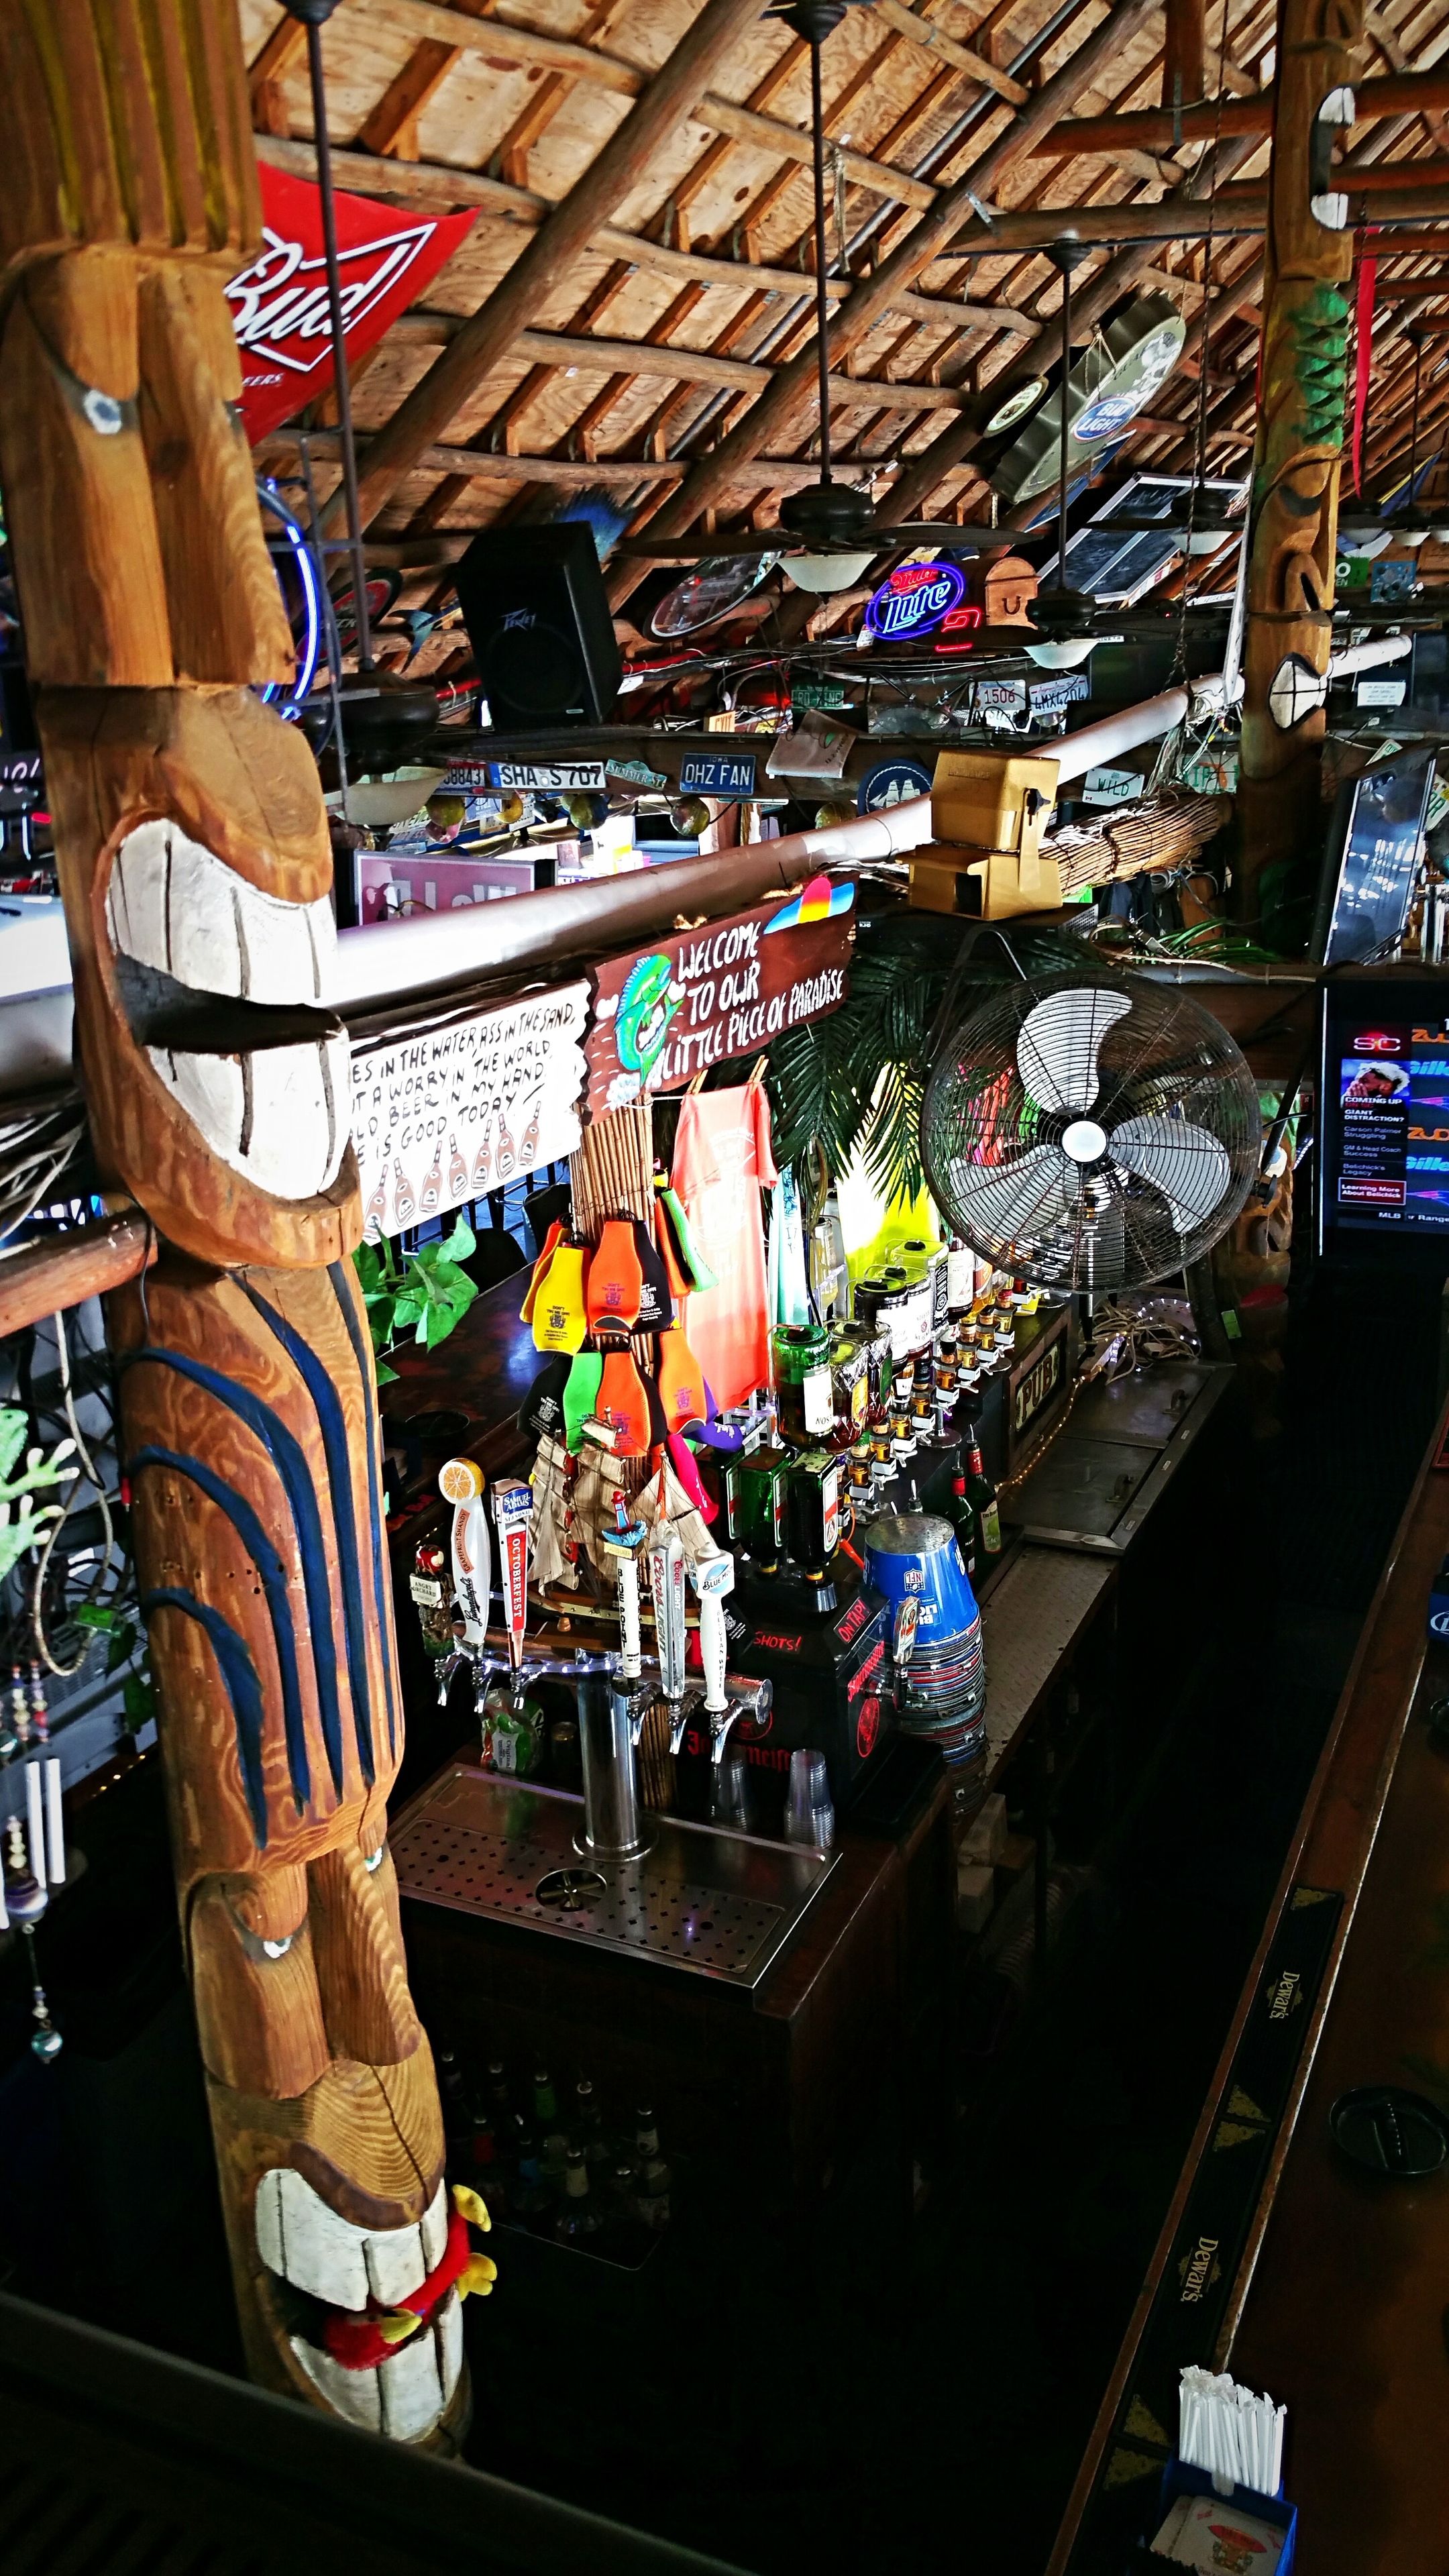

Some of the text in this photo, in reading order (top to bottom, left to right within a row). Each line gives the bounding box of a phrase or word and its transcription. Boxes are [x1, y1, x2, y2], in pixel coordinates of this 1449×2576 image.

[223, 242, 411, 345] Bud
[1097, 402, 1128, 417] BUD
[1077, 418, 1122, 431] LIGHT
[882, 581, 951, 633] Lite
[984, 689, 1016, 704] 1506
[501, 766, 538, 786] SHA
[719, 765, 751, 786] FAN
[1097, 778, 1129, 796] WILD
[678, 922, 761, 981] WELCOME
[686, 960, 761, 1026] TO OUR
[766, 992, 787, 1033] OF
[400, 1042, 427, 1072] THE
[479, 1020, 502, 1048] ASS
[520, 1008, 541, 1036] THE
[1353, 1037, 1401, 1051] SC
[373, 1086, 382, 1108] A
[390, 1067, 448, 1102] WORRY
[474, 1053, 499, 1079] THE
[389, 1093, 439, 1128] BEER
[472, 1081, 496, 1098] MY
[401, 1116, 447, 1150] GOOD
[1342, 1184, 1377, 1192] Learning
[1021, 1354, 1053, 1423] PUB
[504, 1491, 531, 1505] SAMUEL
[506, 1499, 529, 1512] ADAMS
[455, 1511, 470, 1572] GRAPEFRUIT SHANDY
[512, 1537, 523, 1618] OCTOBERFEST
[673, 1559, 684, 1585] Coors
[906, 1573, 923, 1583] NFL
[411, 1587, 436, 1597] ORCHARD
[415, 1582, 432, 1591] ANGRY
[702, 1578, 722, 1591] BLUE
[653, 1555, 667, 1658] Coors LIGHT
[838, 1624, 854, 1643] ON
[846, 1599, 867, 1627] TAP!
[753, 1631, 802, 1652] SHOTS!
